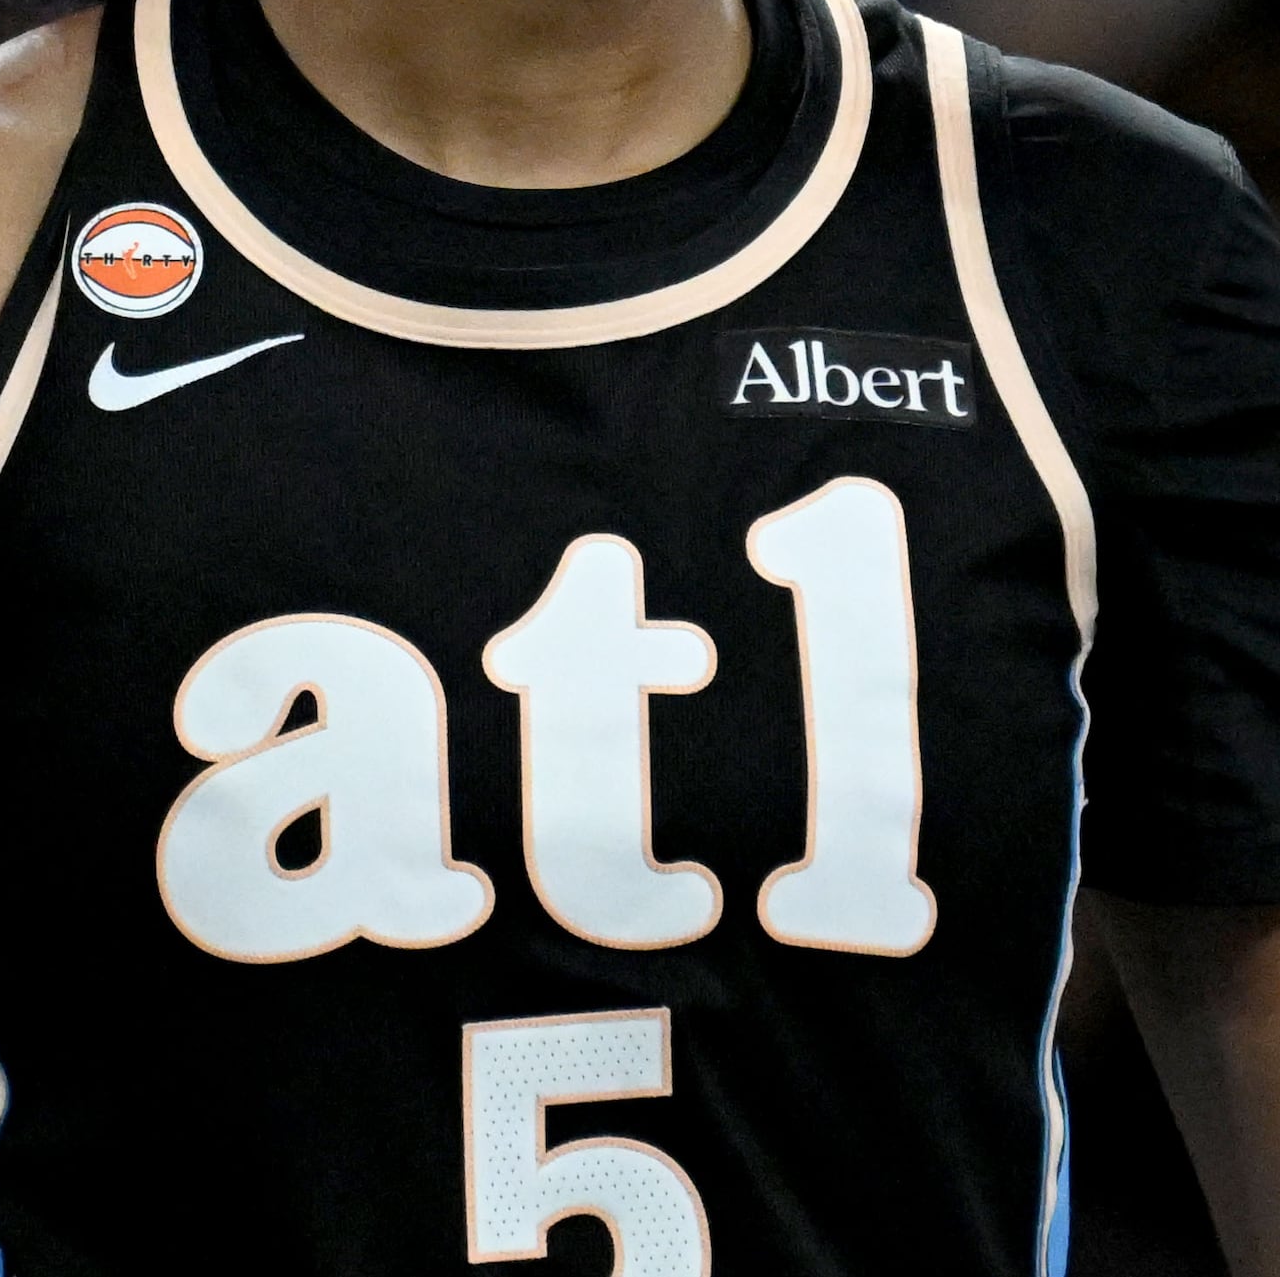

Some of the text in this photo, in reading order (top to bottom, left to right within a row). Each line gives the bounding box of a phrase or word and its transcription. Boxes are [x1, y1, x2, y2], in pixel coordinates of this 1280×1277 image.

[730, 339, 969, 418] Albert
[155, 475, 938, 965] atl
[462, 1007, 711, 1277] 5
